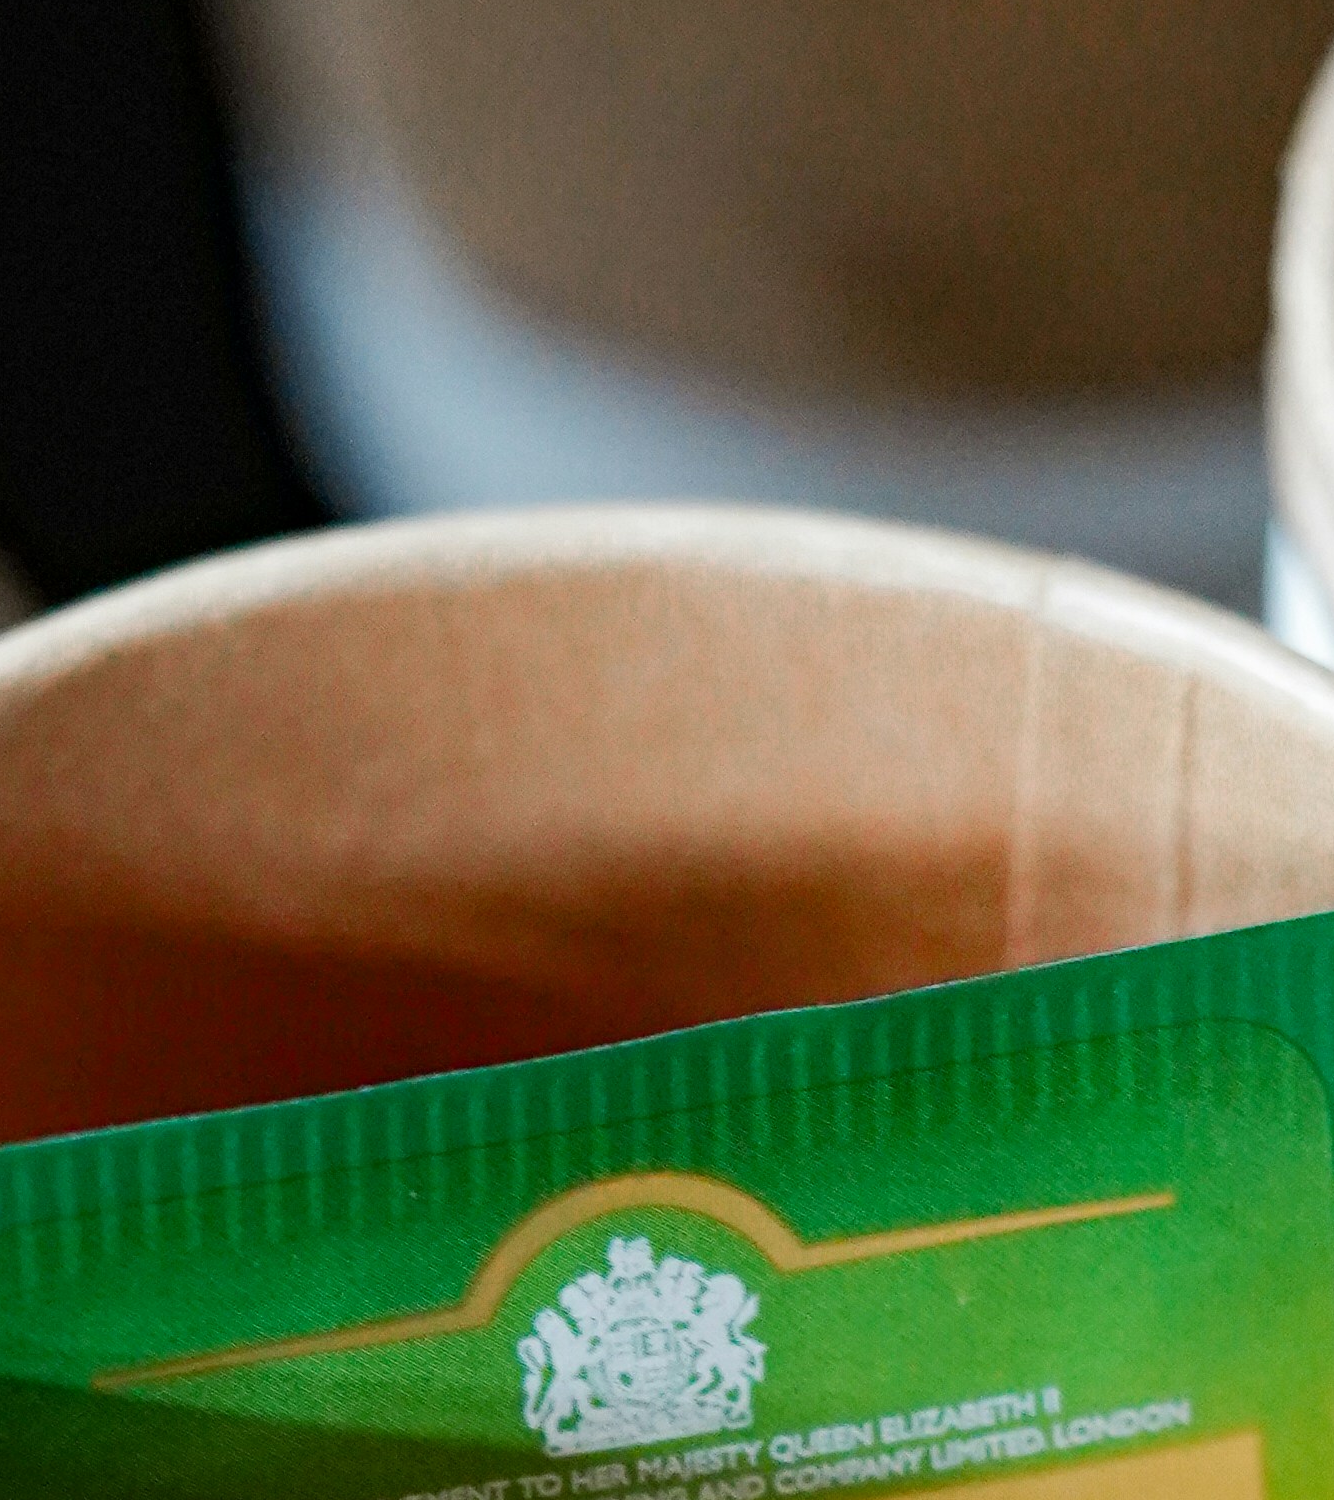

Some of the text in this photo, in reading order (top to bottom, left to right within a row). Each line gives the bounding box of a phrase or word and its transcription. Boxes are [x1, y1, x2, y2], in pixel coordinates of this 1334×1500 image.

[518, 1472, 563, 1499] TO
[571, 1463, 629, 1493] HER
[636, 1441, 762, 1483] MAJESTY
[770, 1422, 873, 1463] QUEEN
[879, 1392, 1036, 1443] ELIZABETH
[774, 1448, 924, 1495] COMPANY
[1052, 1399, 1192, 1448] LONDON
